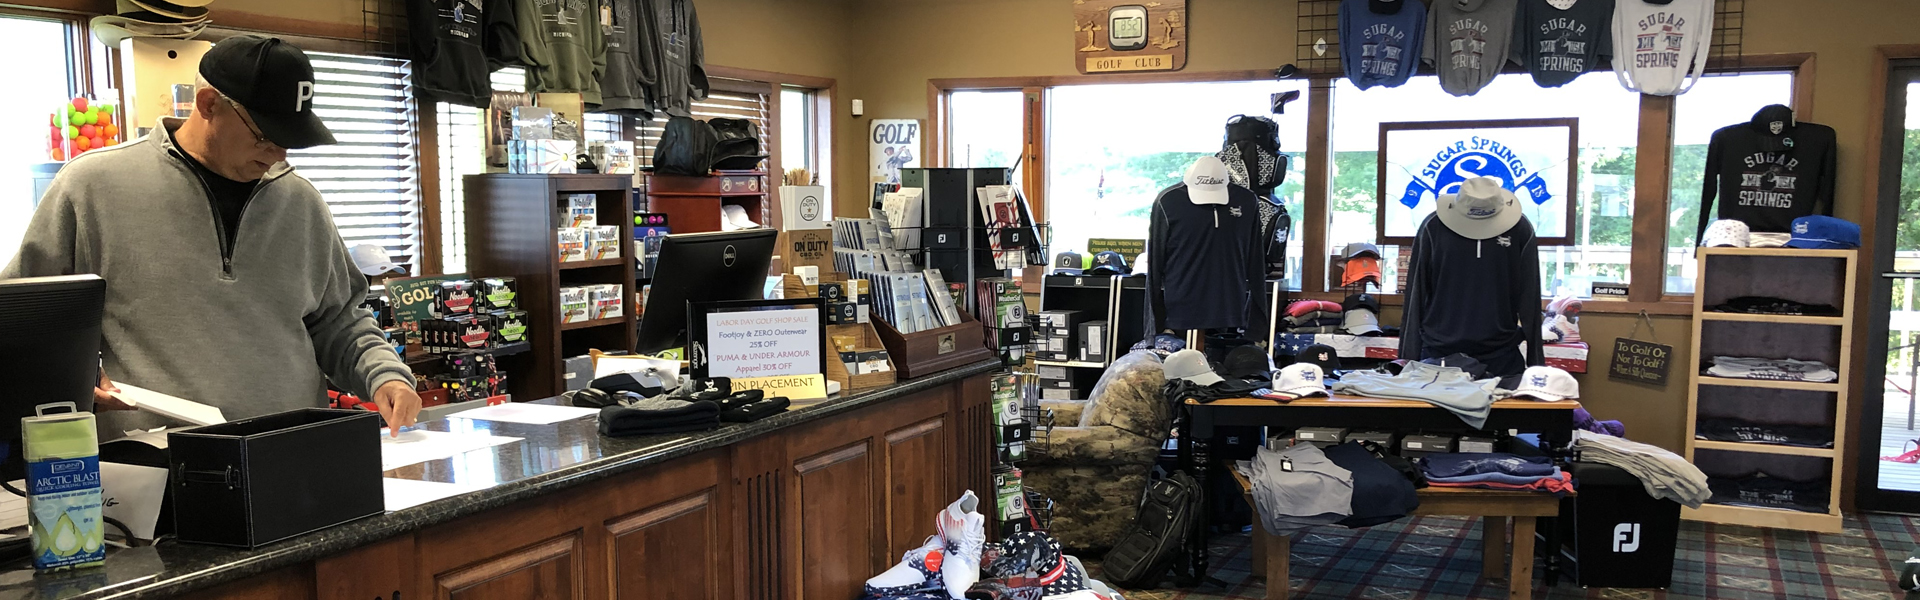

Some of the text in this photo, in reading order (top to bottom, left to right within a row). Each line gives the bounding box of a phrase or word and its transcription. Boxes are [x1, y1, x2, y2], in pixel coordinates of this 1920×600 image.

[1449, 18, 1488, 35] SUGAR
[1540, 17, 1587, 37] SUGAR
[1638, 12, 1685, 31] SUGAR
[1363, 23, 1405, 42] SUGAR
[1096, 58, 1161, 70] GOLF CLUB
[1540, 56, 1584, 72] SPRINGS
[296, 80, 314, 112] P
[873, 124, 917, 145] GOLF
[1422, 136, 1527, 178] SUGAR SPRINGS
[1744, 152, 1798, 170] SUGAR
[1194, 175, 1225, 186] Titleist
[1738, 190, 1792, 208] SPRINGS
[794, 240, 828, 252] ON DUTY
[938, 234, 946, 243] FJ
[402, 287, 434, 305] GOL
[450, 290, 469, 300] Noodle
[466, 326, 485, 336] Noodle
[749, 352, 774, 360] UNDER
[777, 350, 810, 358] ARMOUR
[1617, 341, 1666, 358] To Golf Or
[735, 364, 760, 373] Apparel
[1633, 356, 1642, 365] To
[730, 378, 814, 391] PIN PLACEMENT
[36, 471, 99, 487] ARCTIC BLAST
[1613, 523, 1640, 552] FJ
